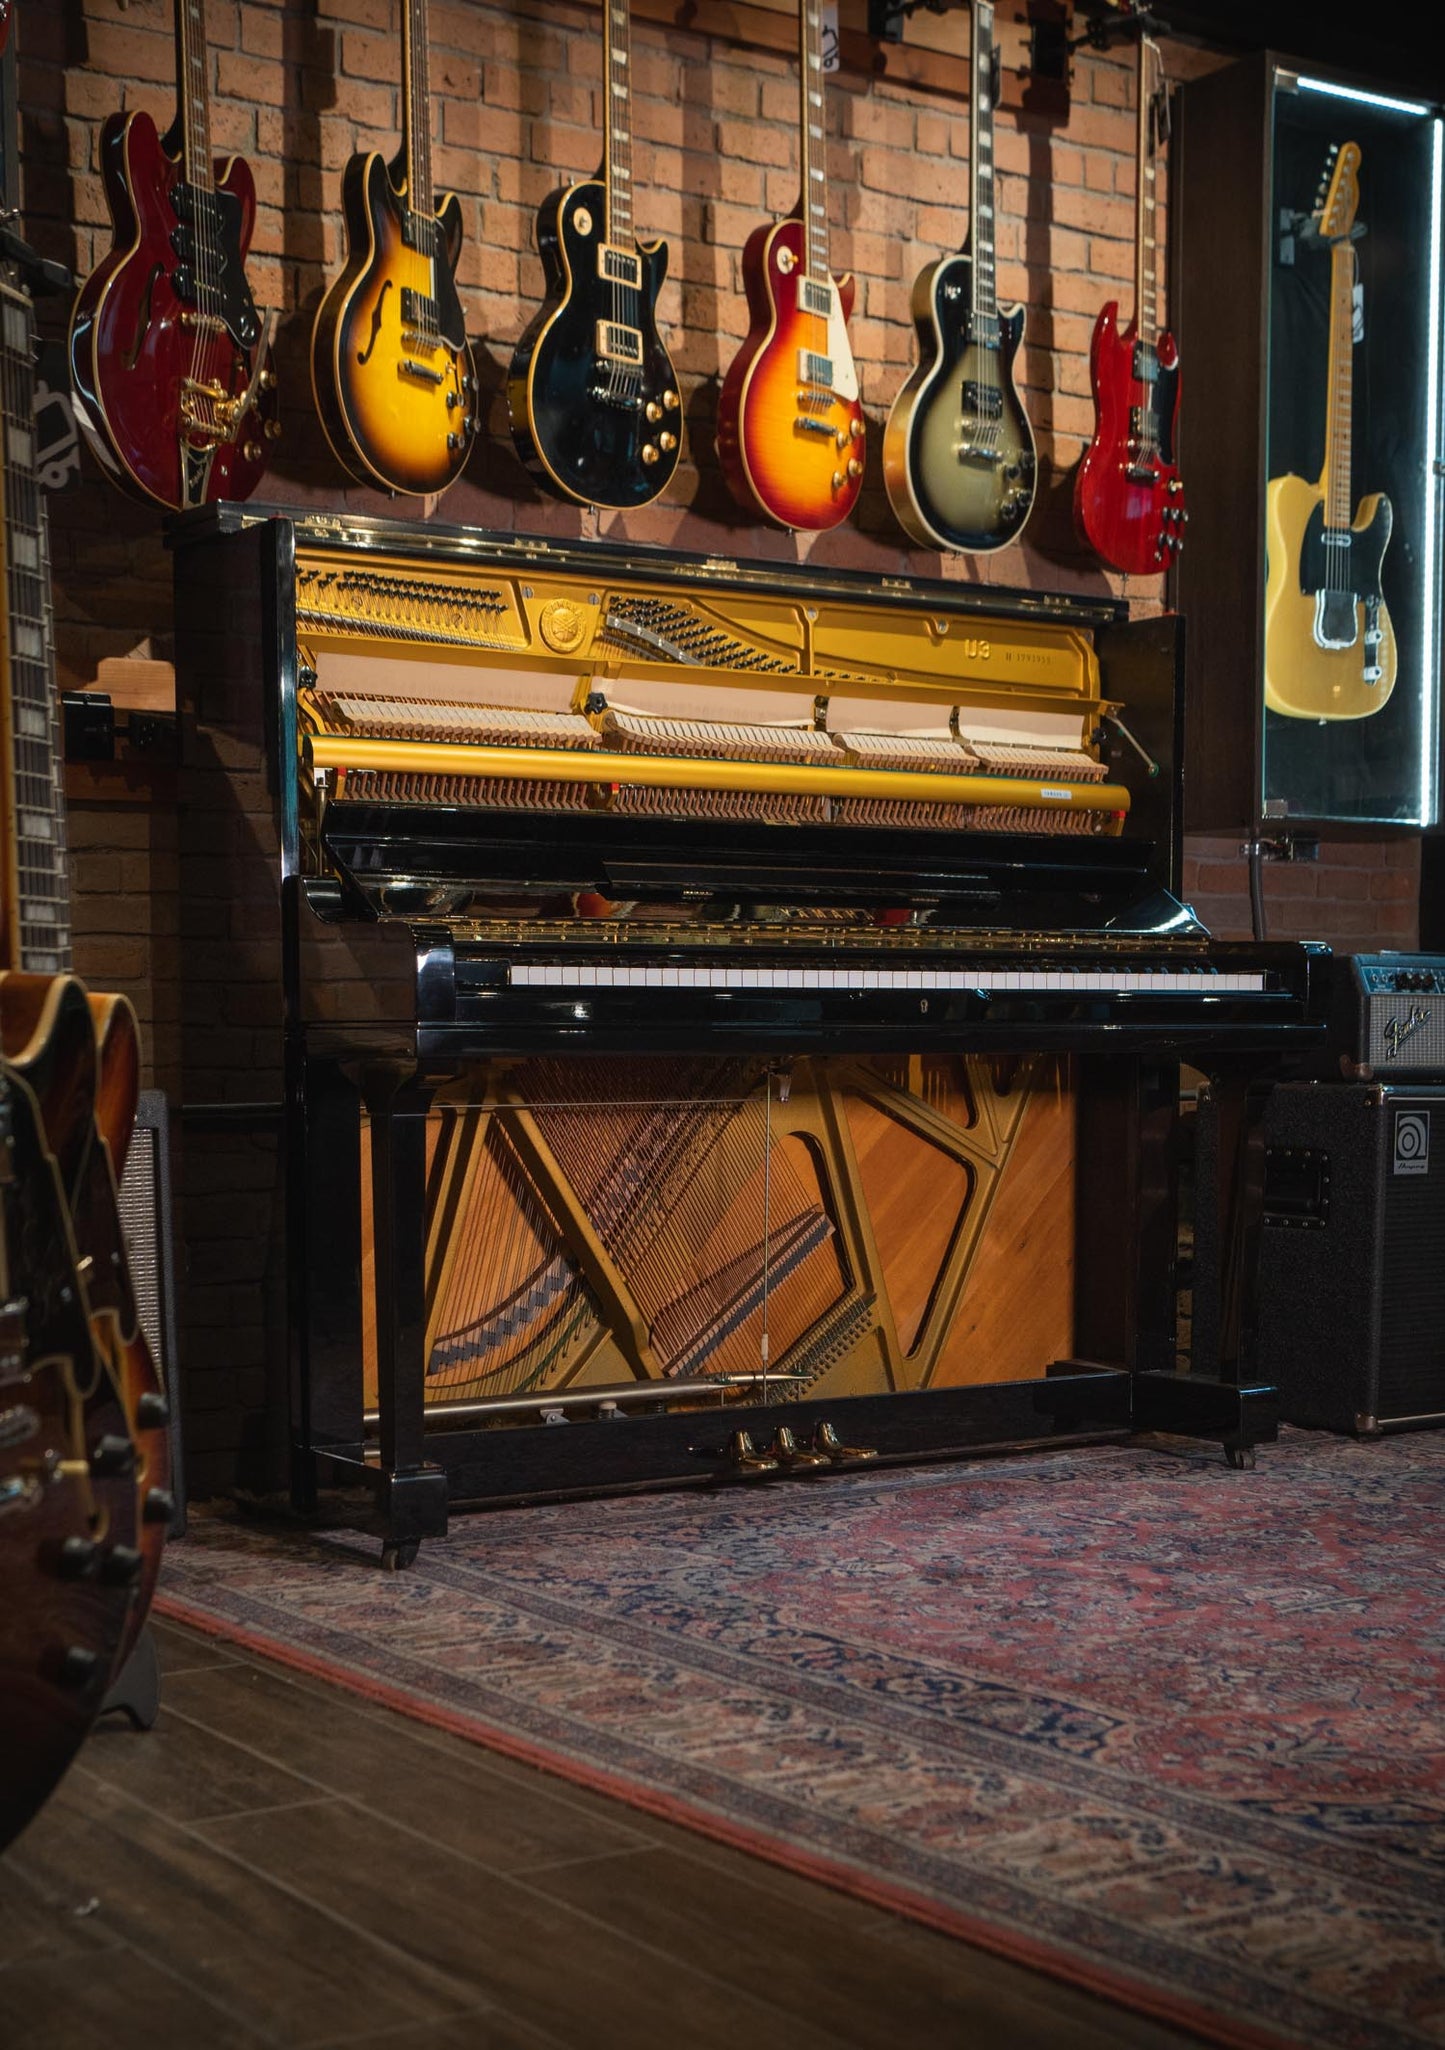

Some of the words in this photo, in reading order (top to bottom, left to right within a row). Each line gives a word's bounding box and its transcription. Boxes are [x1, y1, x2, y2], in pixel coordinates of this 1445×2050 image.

[964, 638, 991, 660] U3
[780, 908, 876, 921] YAMAHA
[1383, 1004, 1432, 1062] Fender
